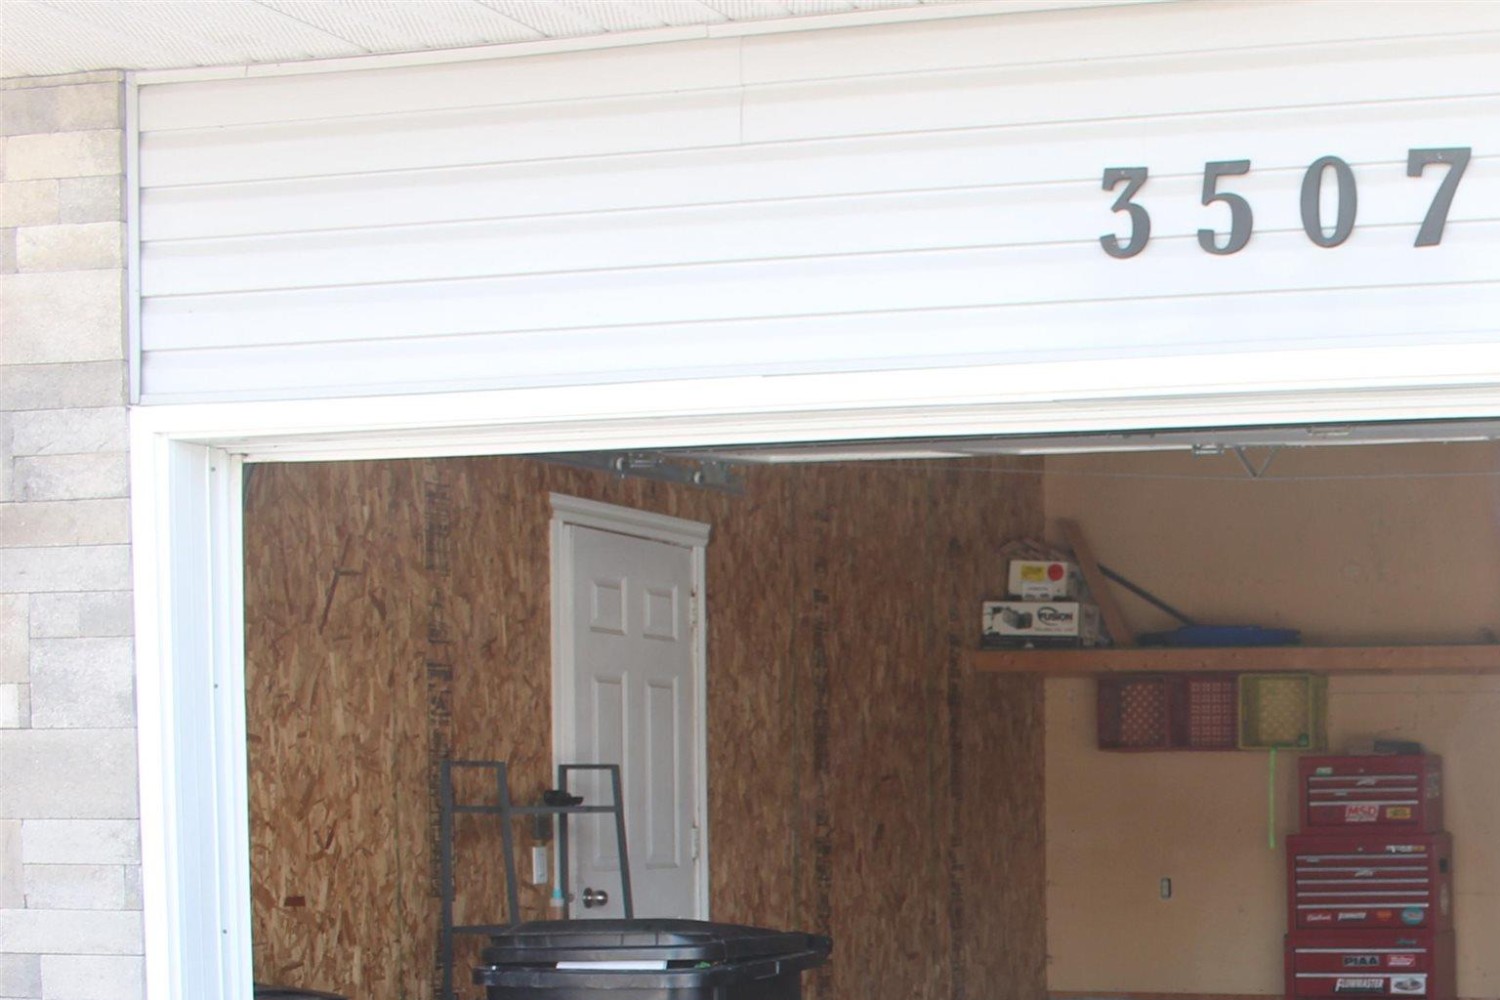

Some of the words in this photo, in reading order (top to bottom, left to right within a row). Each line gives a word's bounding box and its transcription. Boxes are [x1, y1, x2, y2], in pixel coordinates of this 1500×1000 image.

[1099, 146, 1472, 260] 3507
[1347, 805, 1377, 816] MSD
[1344, 956, 1378, 966] PIAA
